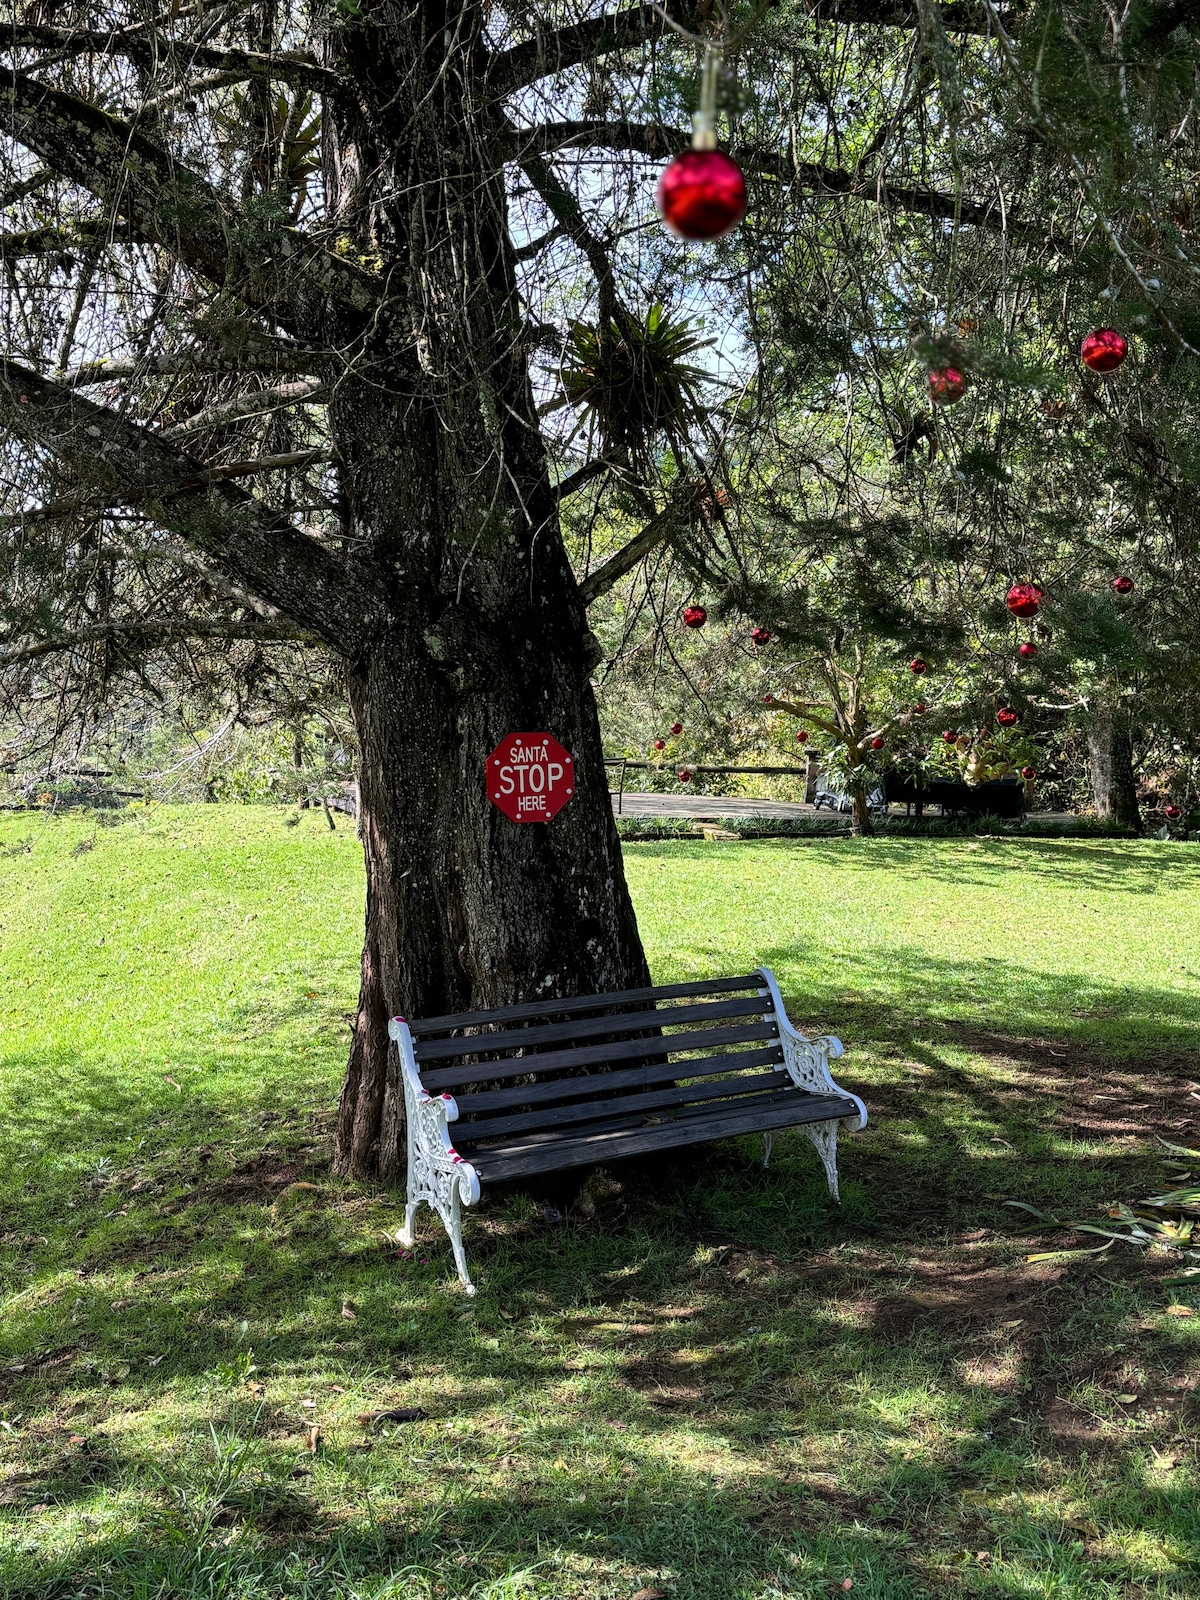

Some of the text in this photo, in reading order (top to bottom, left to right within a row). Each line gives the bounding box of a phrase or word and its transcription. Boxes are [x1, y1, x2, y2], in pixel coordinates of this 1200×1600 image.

[510, 746, 549, 764] SANTA
[499, 763, 564, 794] STOP
[517, 795, 547, 812] HERE
